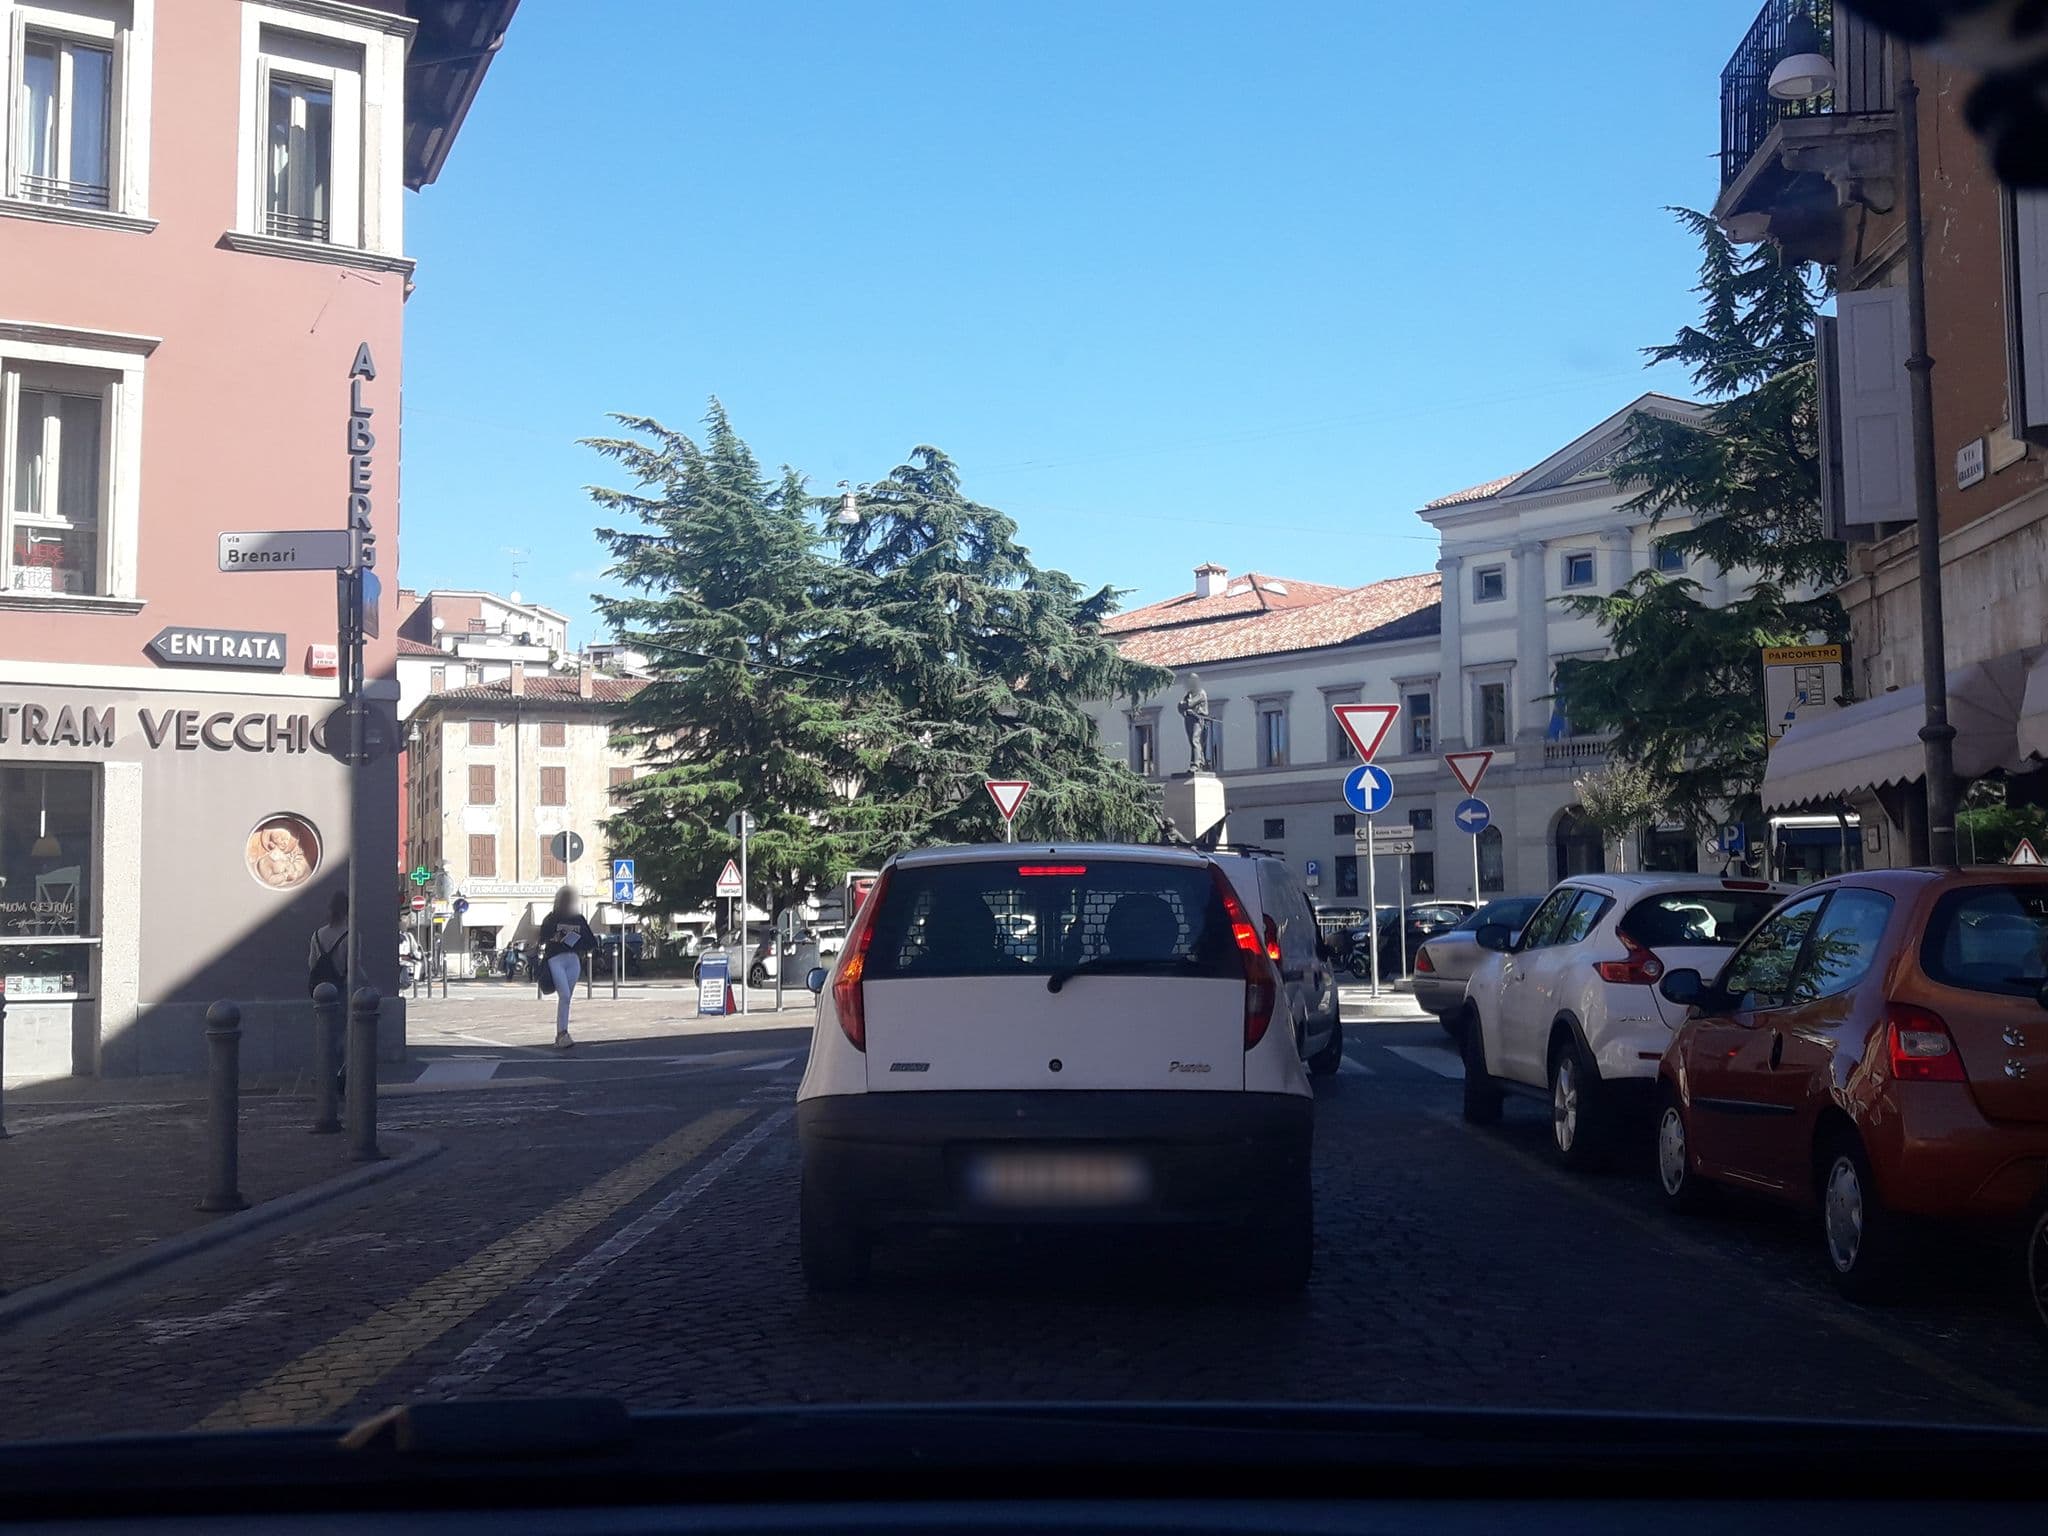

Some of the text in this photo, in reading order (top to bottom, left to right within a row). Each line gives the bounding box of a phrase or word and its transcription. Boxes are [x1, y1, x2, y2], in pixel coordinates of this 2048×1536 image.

[348, 341, 376, 567] ALBERG
[228, 548, 295, 563] Brenari
[171, 634, 281, 660] ENTRATA
[1768, 648, 1838, 660] PARCOMETRO
[1723, 825, 1739, 849] P
[1308, 862, 1316, 874] P
